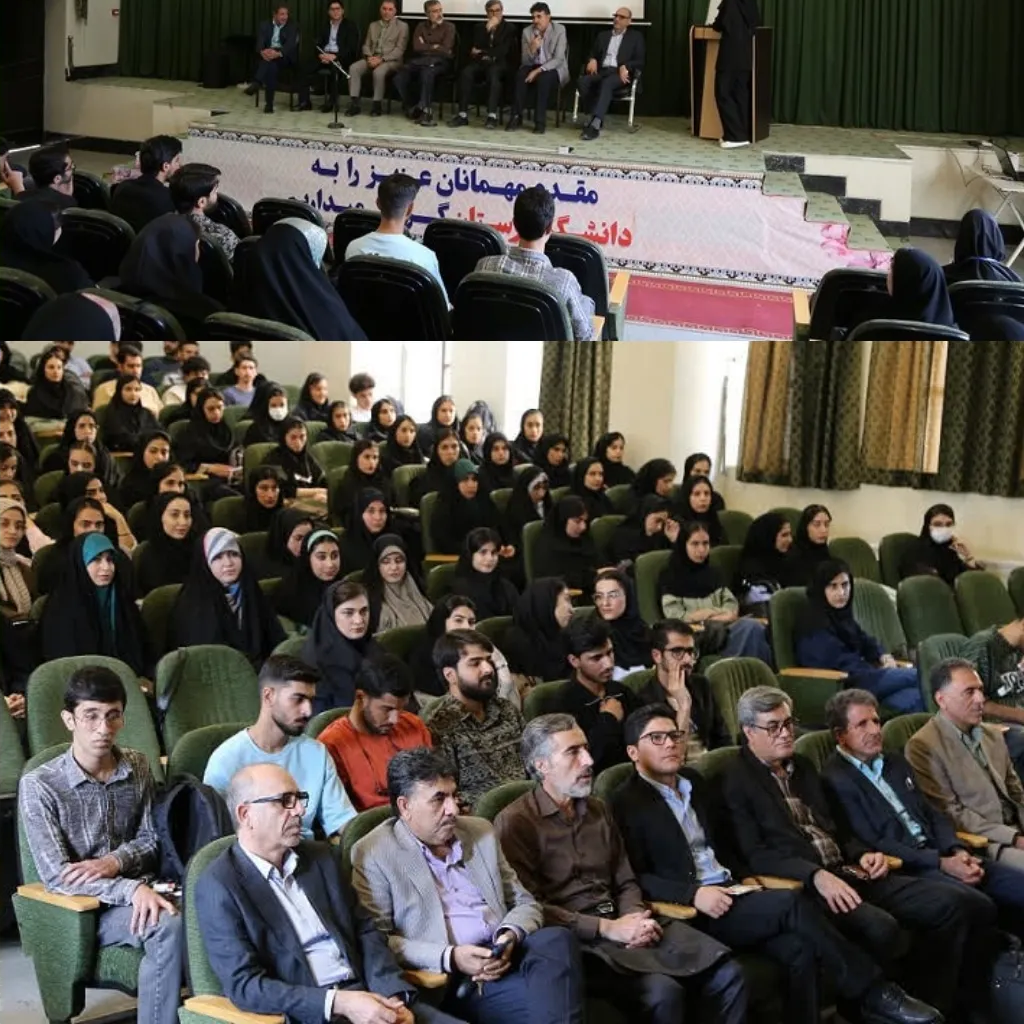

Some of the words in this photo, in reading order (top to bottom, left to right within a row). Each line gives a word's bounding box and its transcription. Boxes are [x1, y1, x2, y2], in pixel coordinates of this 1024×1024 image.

[311, 158, 339, 184] به
[347, 156, 360, 187] را
[436, 167, 526, 202] مهمانان
[536, 180, 598, 204] مقد
